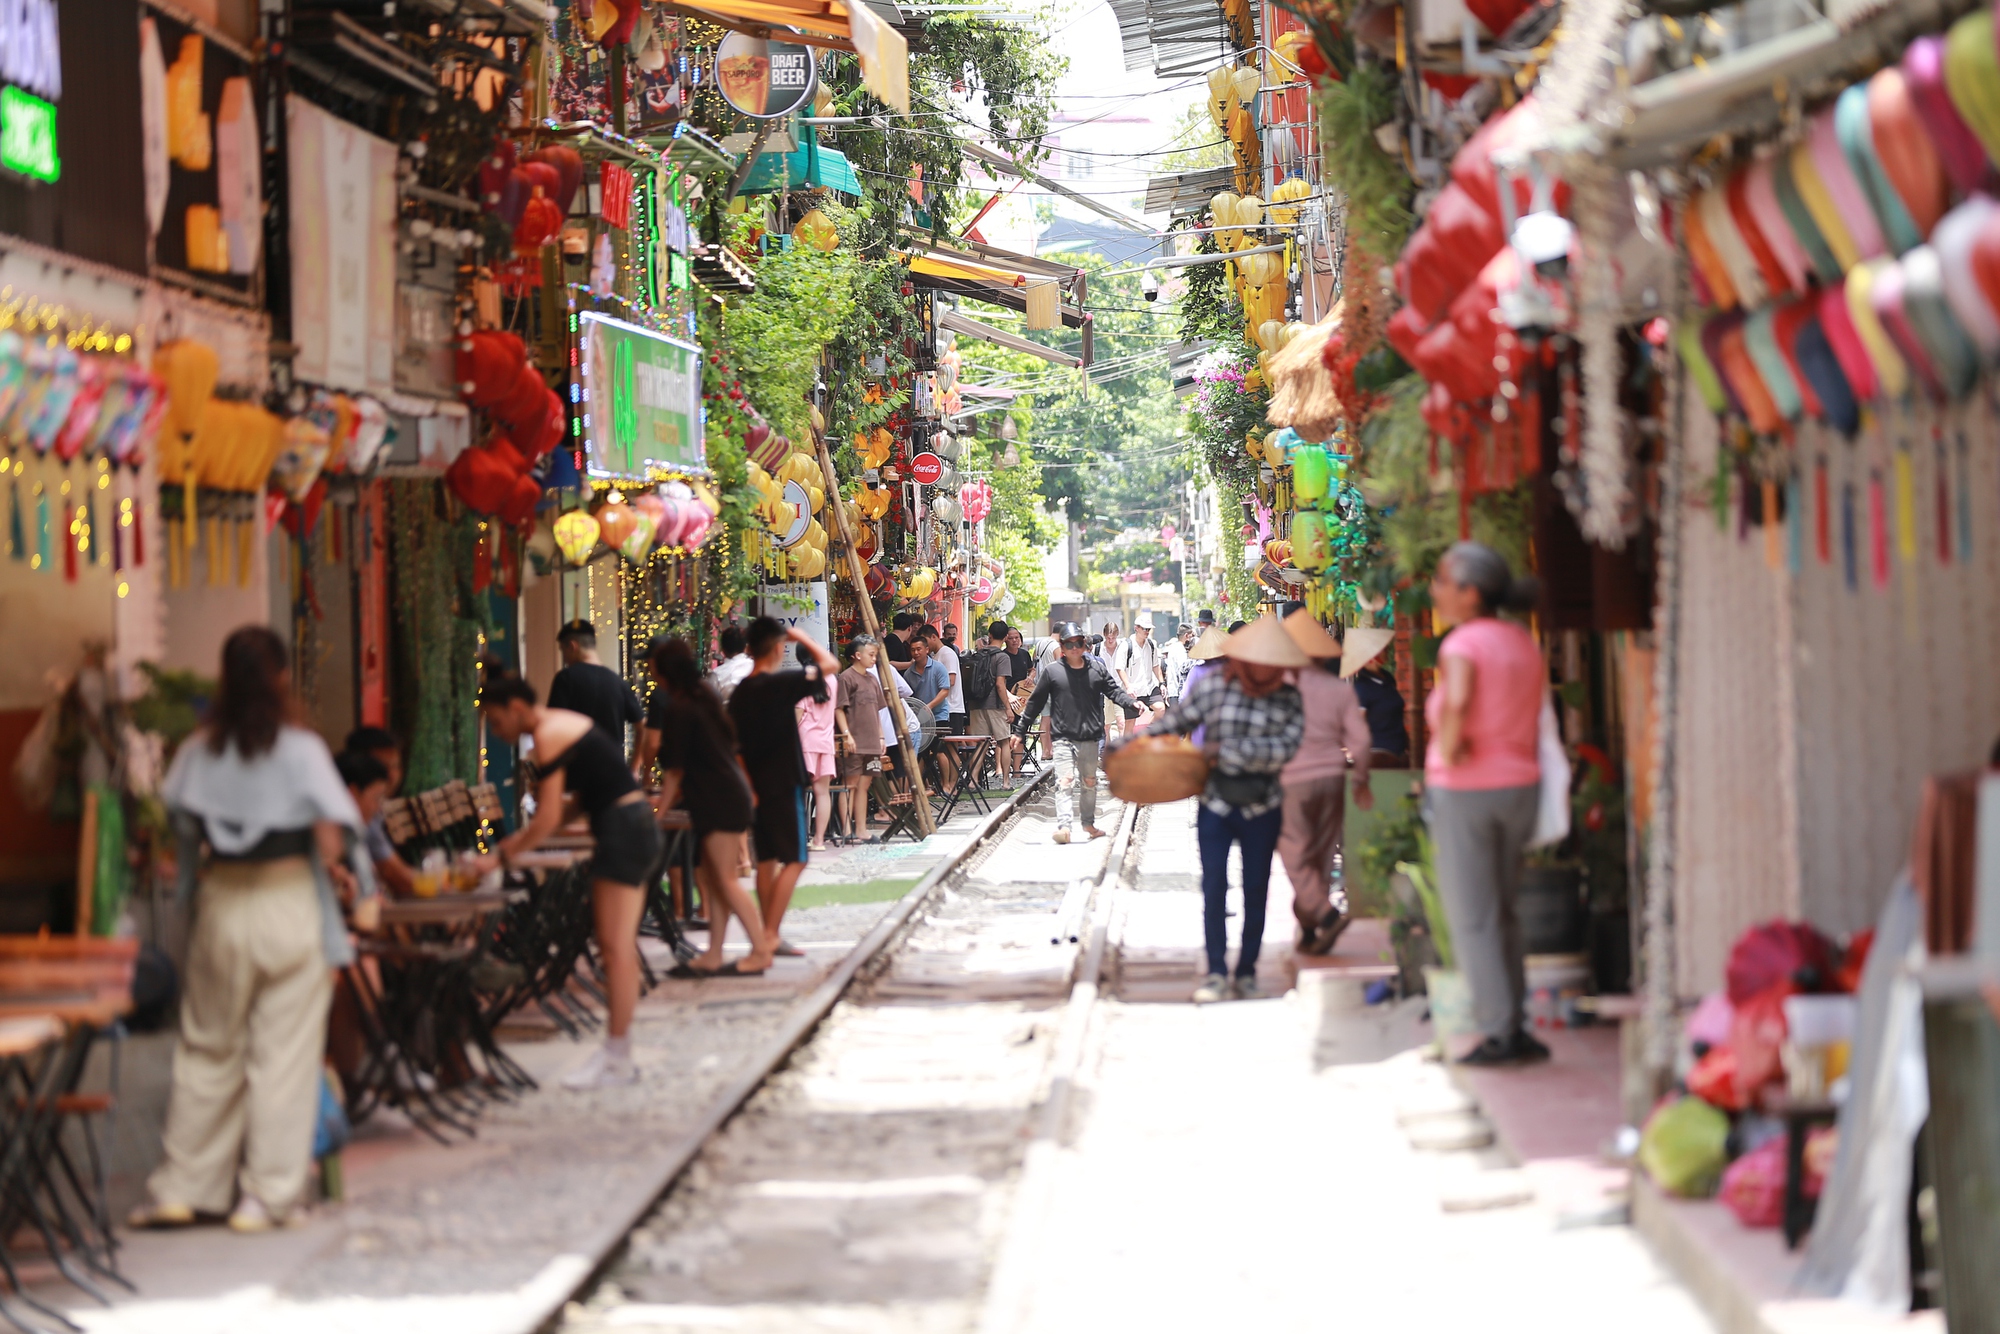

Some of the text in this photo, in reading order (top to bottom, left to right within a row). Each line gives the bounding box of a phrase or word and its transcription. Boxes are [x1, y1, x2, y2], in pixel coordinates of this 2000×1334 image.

[772, 54, 805, 68] DRAFT
[727, 70, 760, 78] SAPPORO
[772, 69, 805, 85] BEER
